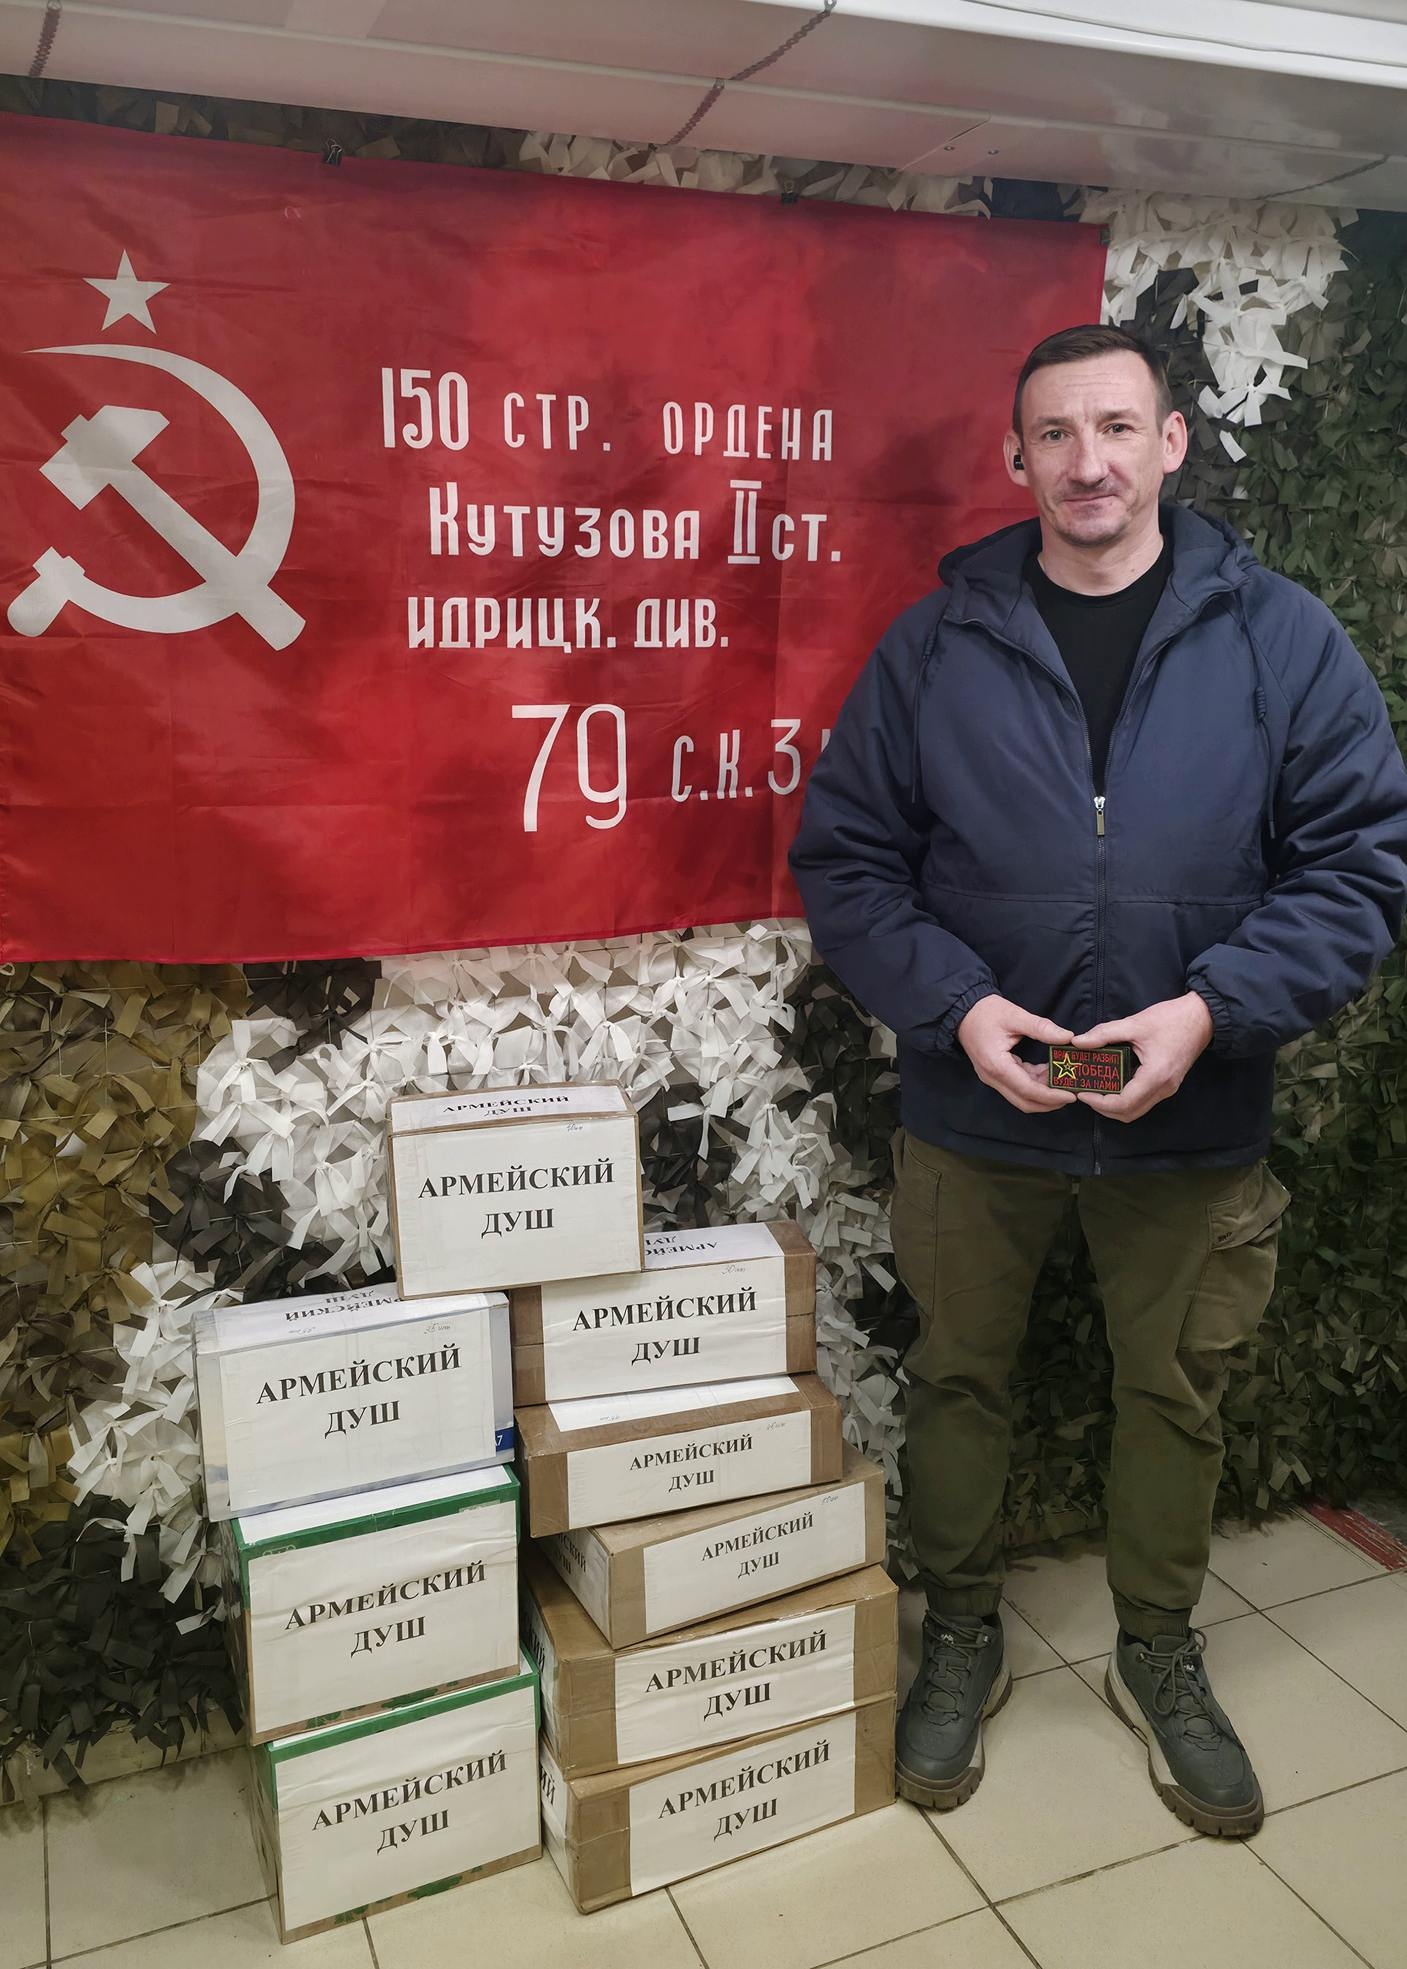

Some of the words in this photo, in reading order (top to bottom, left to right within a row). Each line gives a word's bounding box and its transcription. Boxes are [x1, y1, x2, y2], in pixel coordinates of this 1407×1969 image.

[381, 367, 470, 451] 150
[662, 401, 833, 461] ОРДЕНА
[407, 596, 617, 654] ИДРИЦК.
[633, 598, 729, 648] ДИВ.
[511, 703, 627, 833] 79
[1071, 1051, 1090, 1061] БУДЕТ
[1075, 1063, 1120, 1081] ПОБЕДА
[1053, 1076, 1079, 1088] БУДЕТ
[1080, 1078, 1091, 1089] ЗА
[443, 1095, 569, 1113] АРМЕЙСКИЙ
[484, 1106, 532, 1117] ДУШ
[418, 1157, 614, 1199] АРМЕЙСКИЙ
[481, 1208, 553, 1239] ДУШ
[645, 1241, 718, 1256] АРМЕЙС
[286, 1297, 401, 1322] РМЕЙСКИЙ
[572, 1286, 756, 1332] АРМЕЙСКИЙ
[631, 1336, 700, 1366] ДУШ
[256, 1342, 460, 1405] АРМЕЙСКИЙ
[324, 1400, 400, 1440] ДУШ
[629, 1433, 753, 1471] АРМЕЙСКИЙ
[668, 1469, 714, 1493] ДУШ
[701, 1511, 814, 1561] АРМЕЙСКИЙ
[737, 1551, 779, 1579] ДУШ
[285, 1559, 485, 1630] АРМЕЙСКИЙ
[350, 1616, 425, 1658] ДУШ
[645, 1629, 826, 1693] АРМЕЙСКИЙ
[703, 1682, 770, 1722] ДУШ
[312, 1749, 507, 1831] АРМЕЙСКИЙ
[659, 1739, 829, 1819] АРМЕЙСКИЙ
[376, 1809, 449, 1855] ДУШ
[713, 1798, 777, 1841] ДУШ
